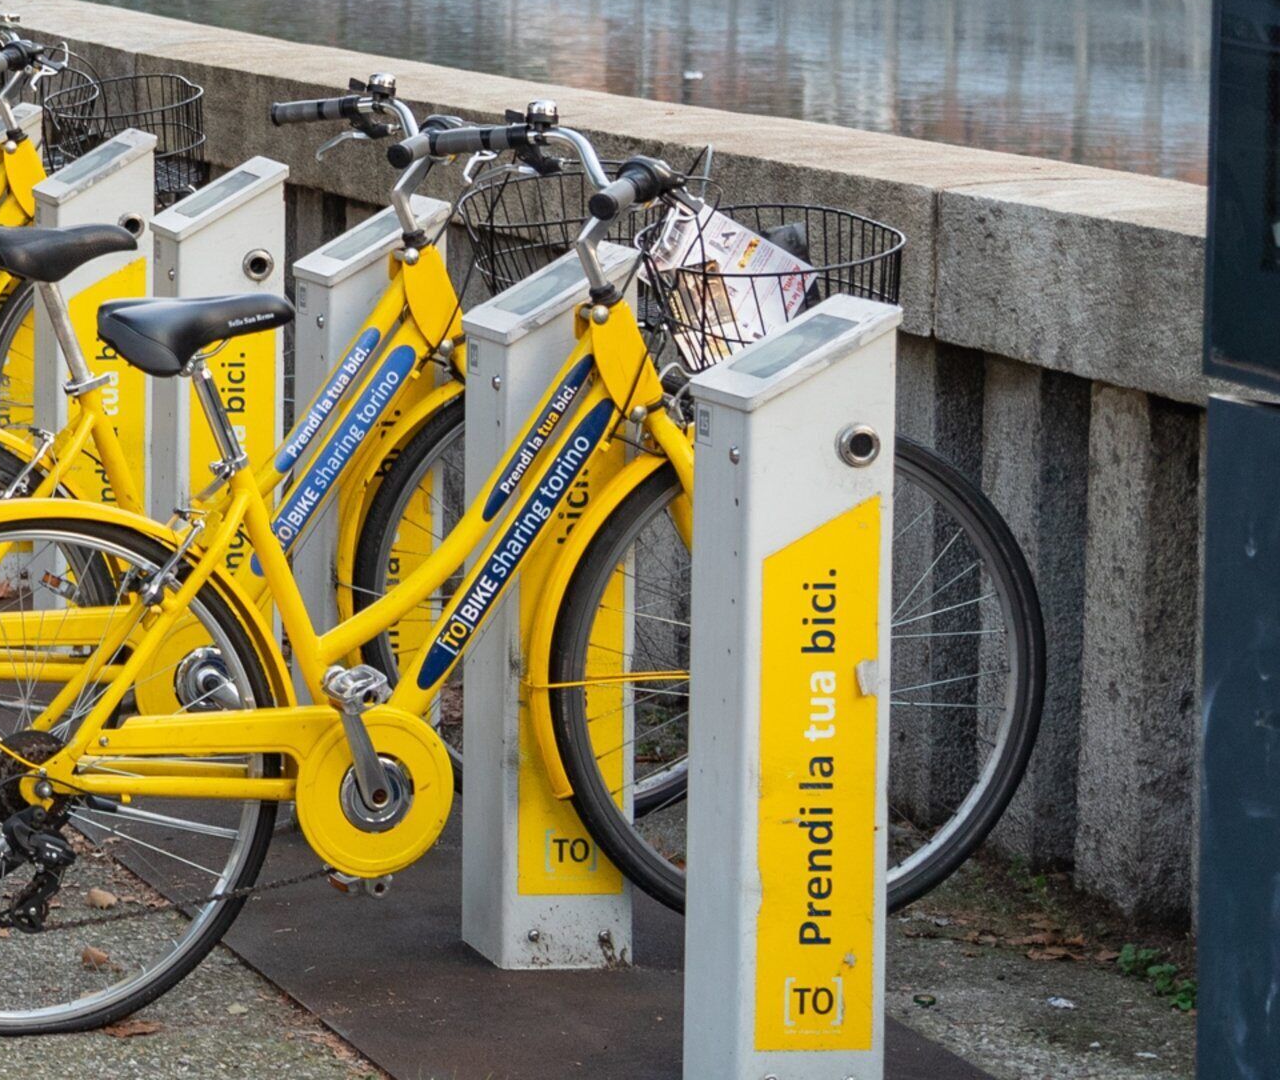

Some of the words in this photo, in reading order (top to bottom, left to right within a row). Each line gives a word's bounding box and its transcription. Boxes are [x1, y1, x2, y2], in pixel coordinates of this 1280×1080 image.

[221, 352, 246, 413] bici.
[286, 412, 323, 459] Prendi
[316, 396, 334, 415] la
[326, 374, 351, 401] tua
[343, 348, 371, 376] bici.
[314, 424, 365, 490] sharing
[356, 369, 400, 425] torino
[499, 448, 534, 496] Prendi
[527, 433, 543, 452] la
[537, 411, 560, 438] tua
[556, 384, 579, 412] bici.
[492, 499, 552, 578] sharing
[540, 434, 591, 500] torino
[800, 568, 838, 654] bici.
[803, 669, 838, 742] tua
[798, 755, 835, 790] la
[798, 807, 834, 945] Prendi
